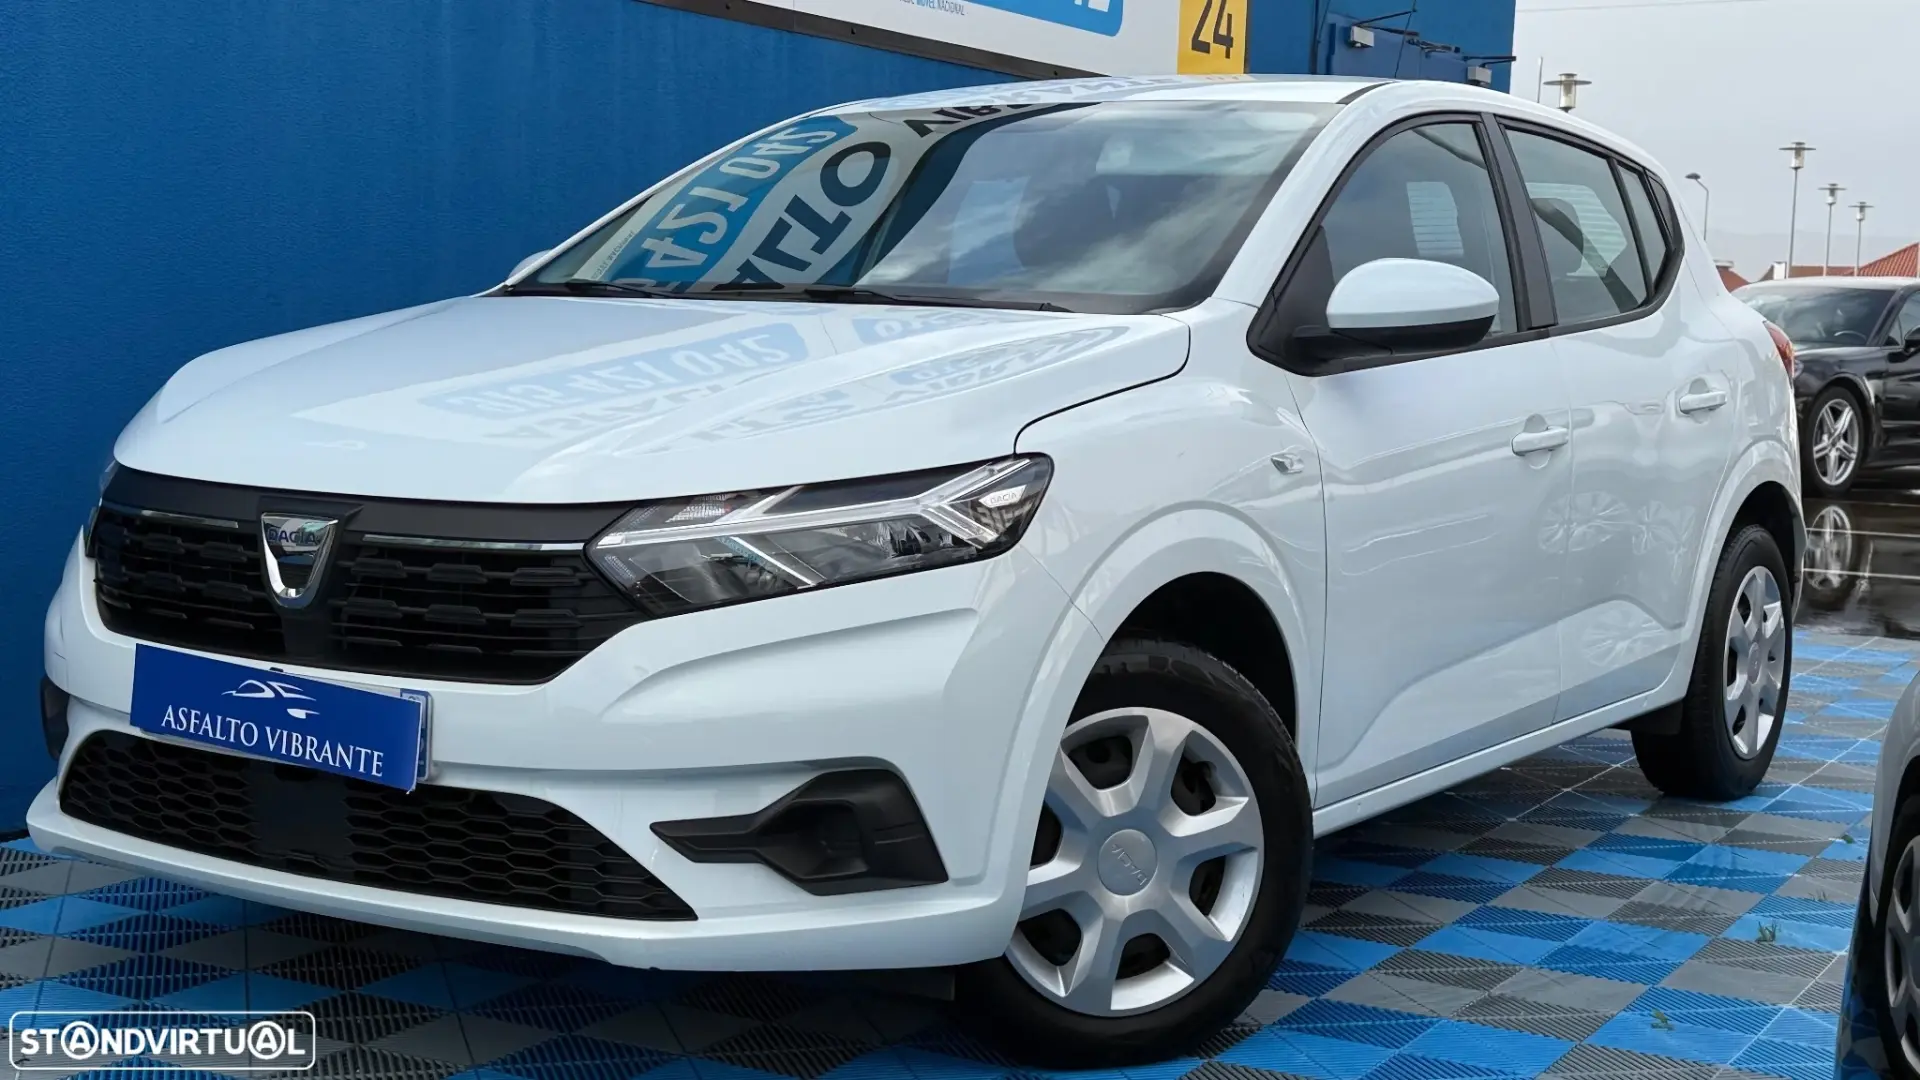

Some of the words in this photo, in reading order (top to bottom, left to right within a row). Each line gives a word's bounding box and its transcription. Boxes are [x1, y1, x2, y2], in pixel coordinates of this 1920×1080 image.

[267, 528, 316, 546] DACIA
[161, 705, 259, 746] ASFALTO
[265, 726, 384, 777] VIBRANTE
